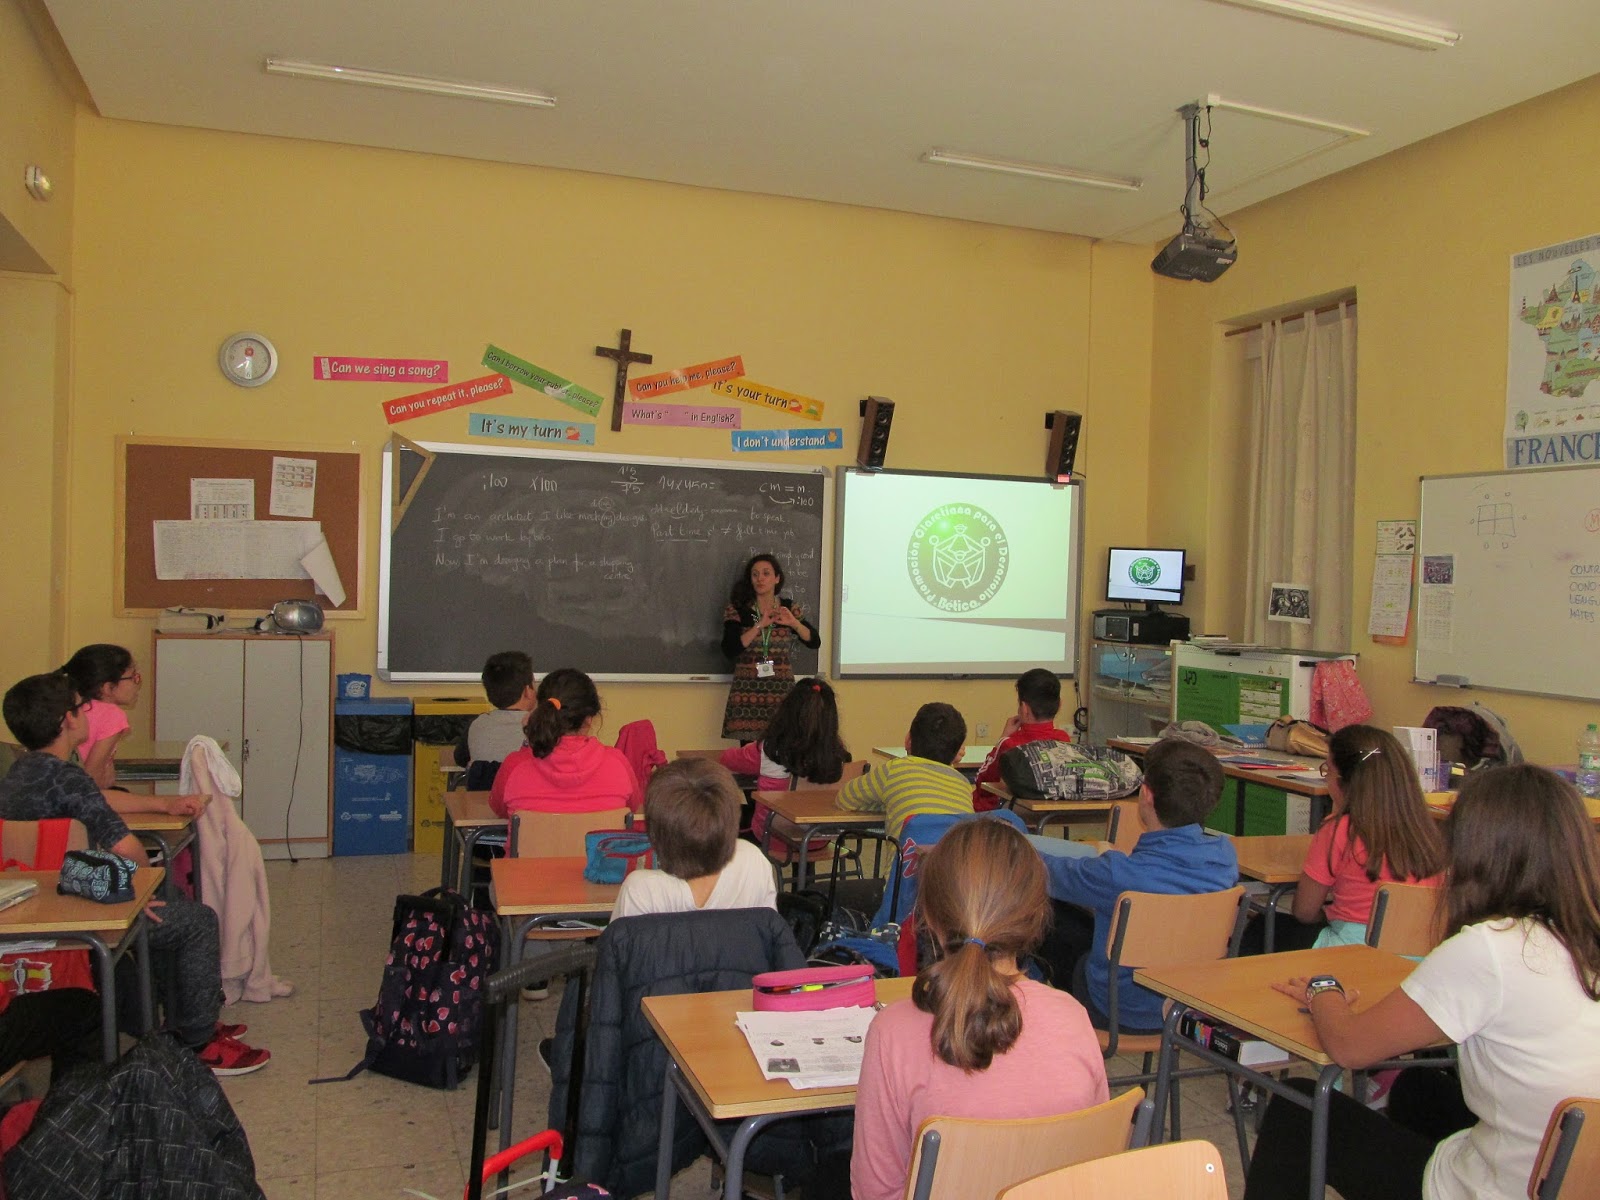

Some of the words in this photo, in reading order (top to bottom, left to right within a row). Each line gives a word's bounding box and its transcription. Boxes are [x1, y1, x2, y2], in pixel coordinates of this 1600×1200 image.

[331, 361, 352, 374] Can
[354, 363, 371, 375] we
[373, 362, 397, 377] sing
[398, 365, 405, 376] a
[407, 363, 441, 378] song?
[636, 381, 652, 393] Can
[653, 379, 669, 391] you
[670, 373, 688, 388] help
[688, 370, 704, 381] me,
[705, 361, 738, 379] please?
[487, 352, 501, 363] Can
[505, 360, 530, 377] borrow
[530, 372, 546, 384] your
[572, 392, 600, 408] please?
[389, 403, 407, 416] Can
[409, 401, 426, 414] you
[426, 391, 456, 408] repeat
[457, 387, 469, 400] it,
[470, 378, 504, 398] please?
[713, 380, 733, 394] It's
[737, 386, 763, 402] your
[765, 392, 789, 408] turn
[631, 408, 663, 420] What's
[690, 412, 699, 422] in
[700, 412, 735, 424] English?
[480, 417, 505, 433] It's
[508, 423, 528, 438] my
[532, 422, 562, 439] turn
[736, 437, 742, 448] I
[743, 436, 769, 448] don't
[771, 434, 826, 448] understand
[464, 512, 481, 520] an
[556, 508, 574, 520] like
[973, 510, 997, 532] para
[452, 535, 466, 549] go
[469, 531, 481, 542] to
[486, 531, 515, 542] work
[994, 532, 1006, 544] el
[547, 553, 568, 572] plan
[978, 546, 1008, 601] Desarrollo
